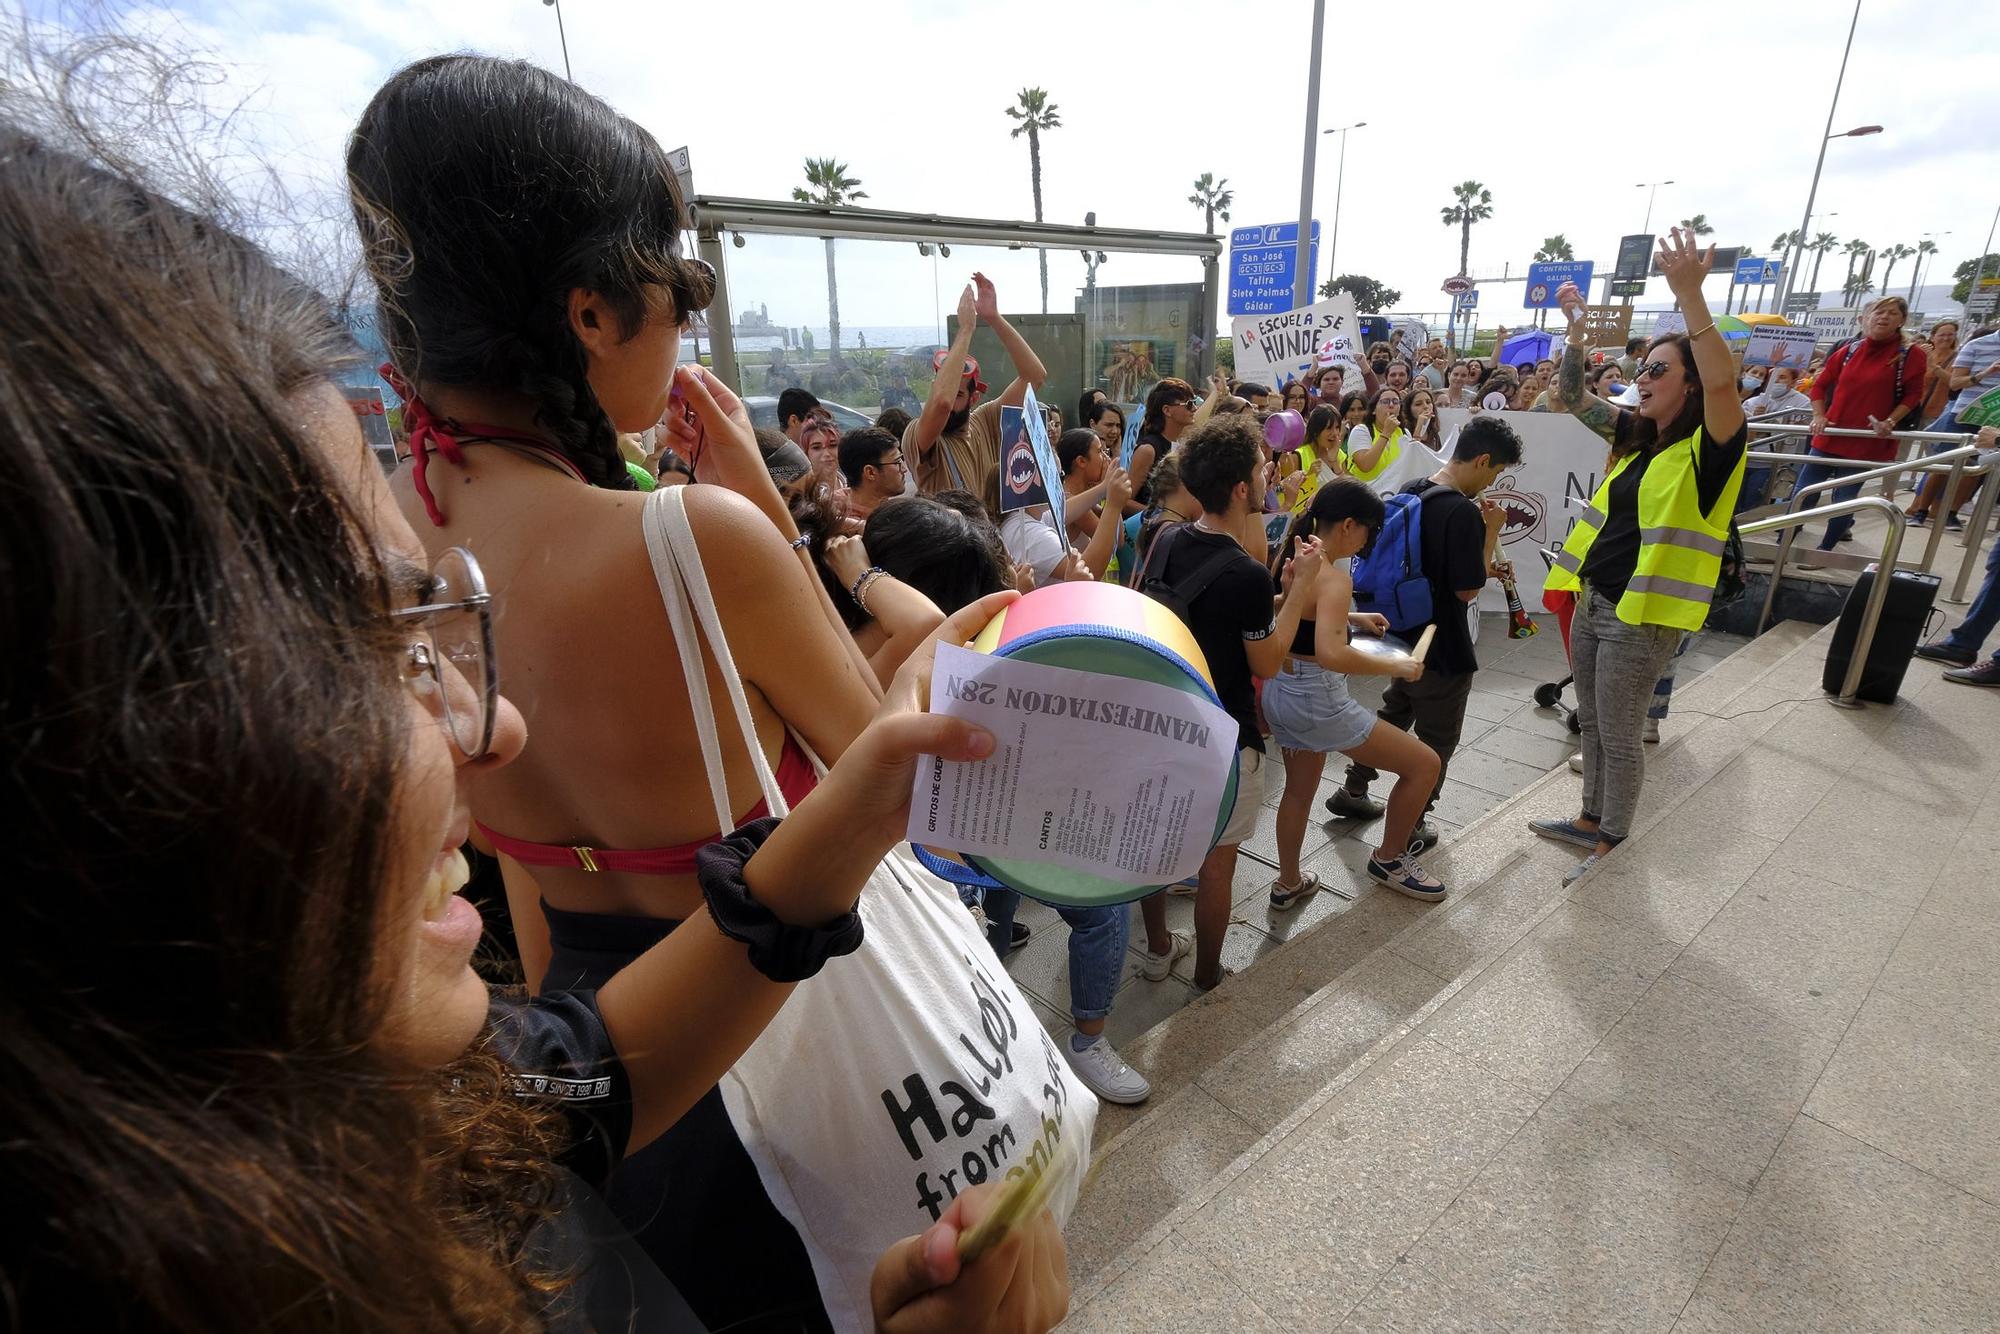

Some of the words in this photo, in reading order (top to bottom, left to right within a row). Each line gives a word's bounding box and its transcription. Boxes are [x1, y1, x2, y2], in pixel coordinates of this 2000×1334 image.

[1242, 254, 1258, 262] San
[1262, 251, 1282, 260] José
[1248, 276, 1274, 285] Tafira
[1232, 289, 1253, 298] Siete
[1257, 288, 1289, 296] Palmas
[1245, 301, 1273, 310] Gáldar
[1258, 313, 1313, 336] ESCUELA
[1320, 315, 1344, 330] SE
[1814, 317, 1845, 326] ENTRADA
[1240, 330, 1255, 350] LA
[1260, 330, 1323, 364] HUNDE
[946, 674, 998, 705] 28N
[1004, 687, 1210, 749] MANIFESTACIÓN
[933, 756, 943, 781] GUER
[931, 783, 940, 795] DE
[927, 796, 938, 832] GRITOS
[1038, 810, 1053, 849] CANTOS
[549, 1082, 576, 1096] SINCE
[916, 1123, 1016, 1224] from
